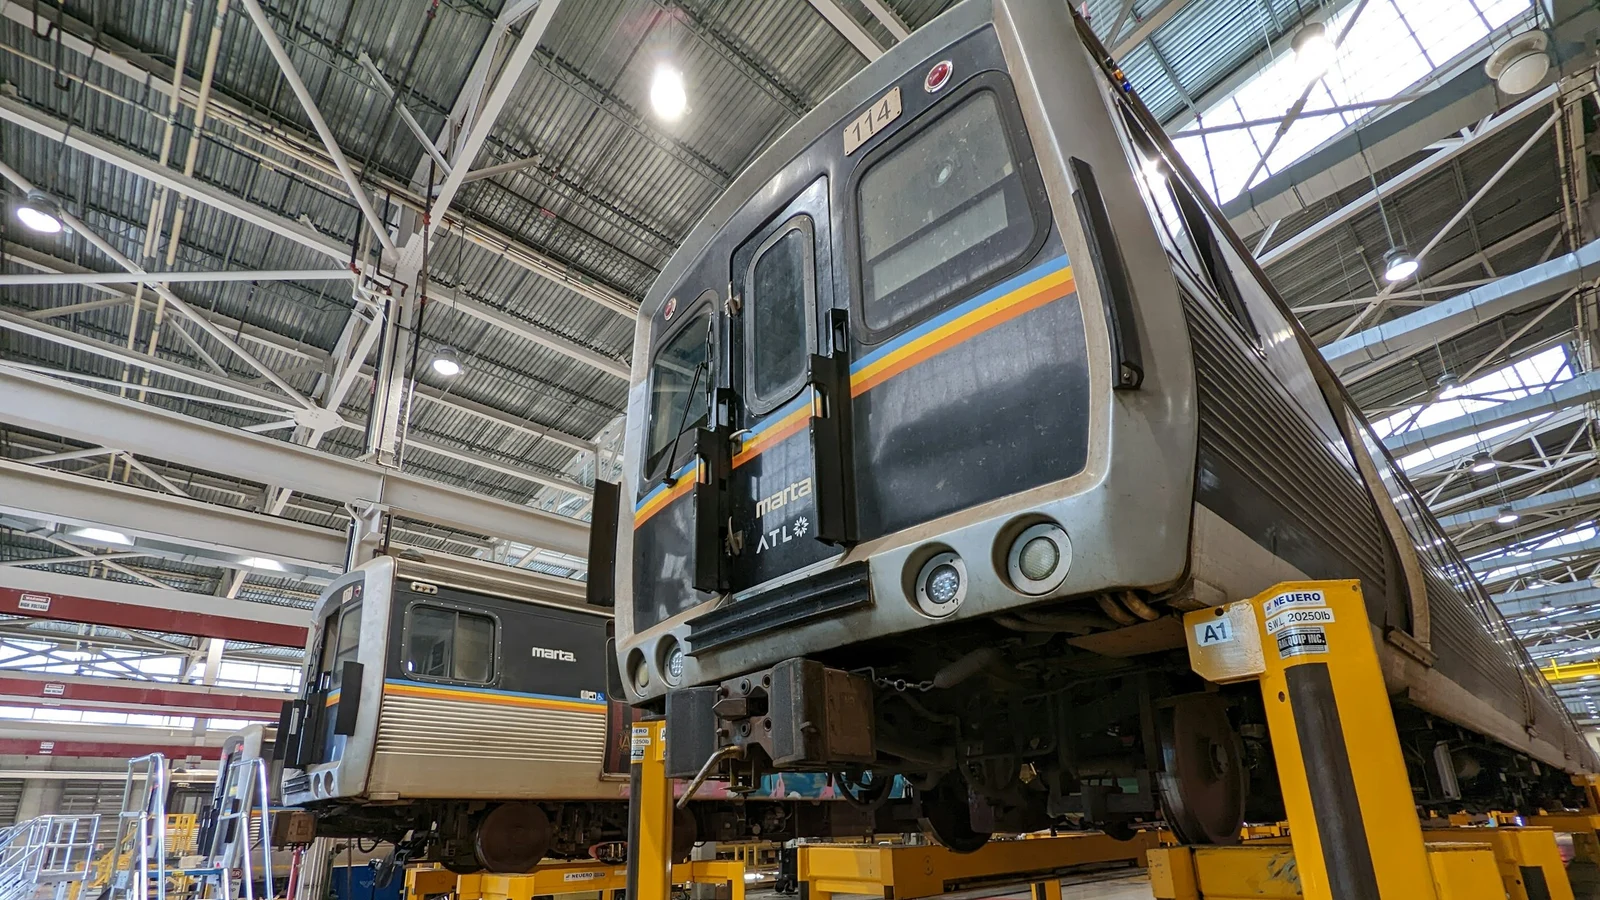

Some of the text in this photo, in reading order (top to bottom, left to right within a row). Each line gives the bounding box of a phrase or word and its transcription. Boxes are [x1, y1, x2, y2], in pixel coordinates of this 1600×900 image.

[852, 99, 891, 142] 114
[756, 477, 812, 519] marta
[756, 525, 793, 554] ATL
[1273, 592, 1321, 608] NEUERO
[1287, 611, 1331, 623] 20250lb
[1203, 622, 1228, 643] A1
[532, 647, 574, 662] marta
